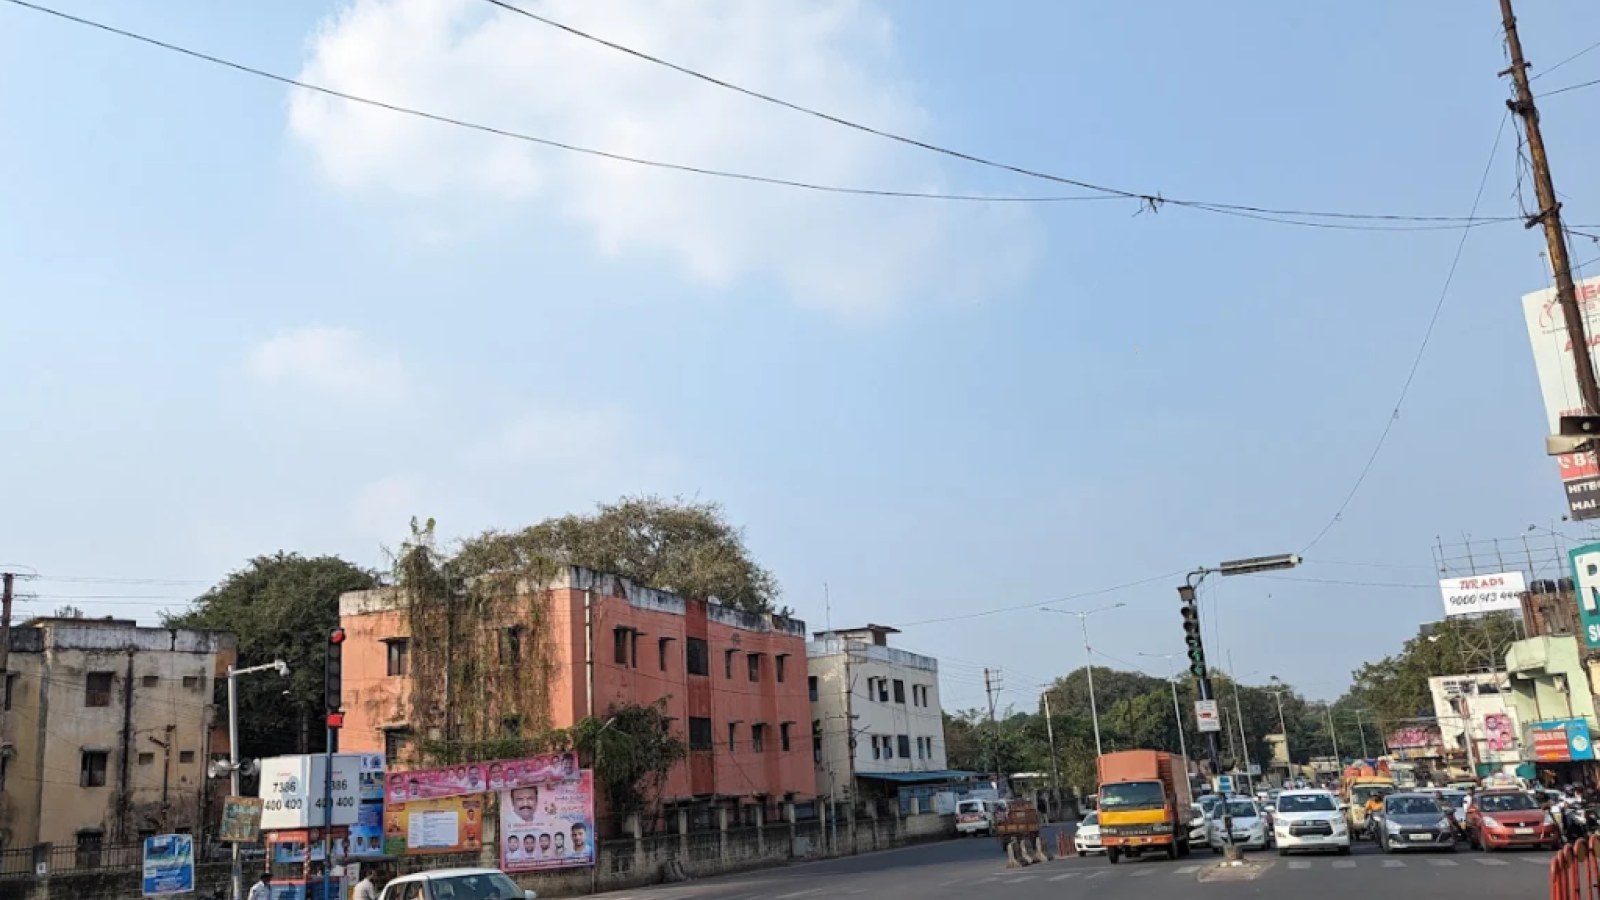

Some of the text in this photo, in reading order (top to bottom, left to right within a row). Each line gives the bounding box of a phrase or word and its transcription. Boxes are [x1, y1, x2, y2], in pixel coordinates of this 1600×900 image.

[1450, 594, 1476, 606] 9000
[273, 781, 296, 793] 7386
[325, 779, 348, 791] 386
[264, 798, 303, 811] 400 400
[336, 796, 354, 807] 400
